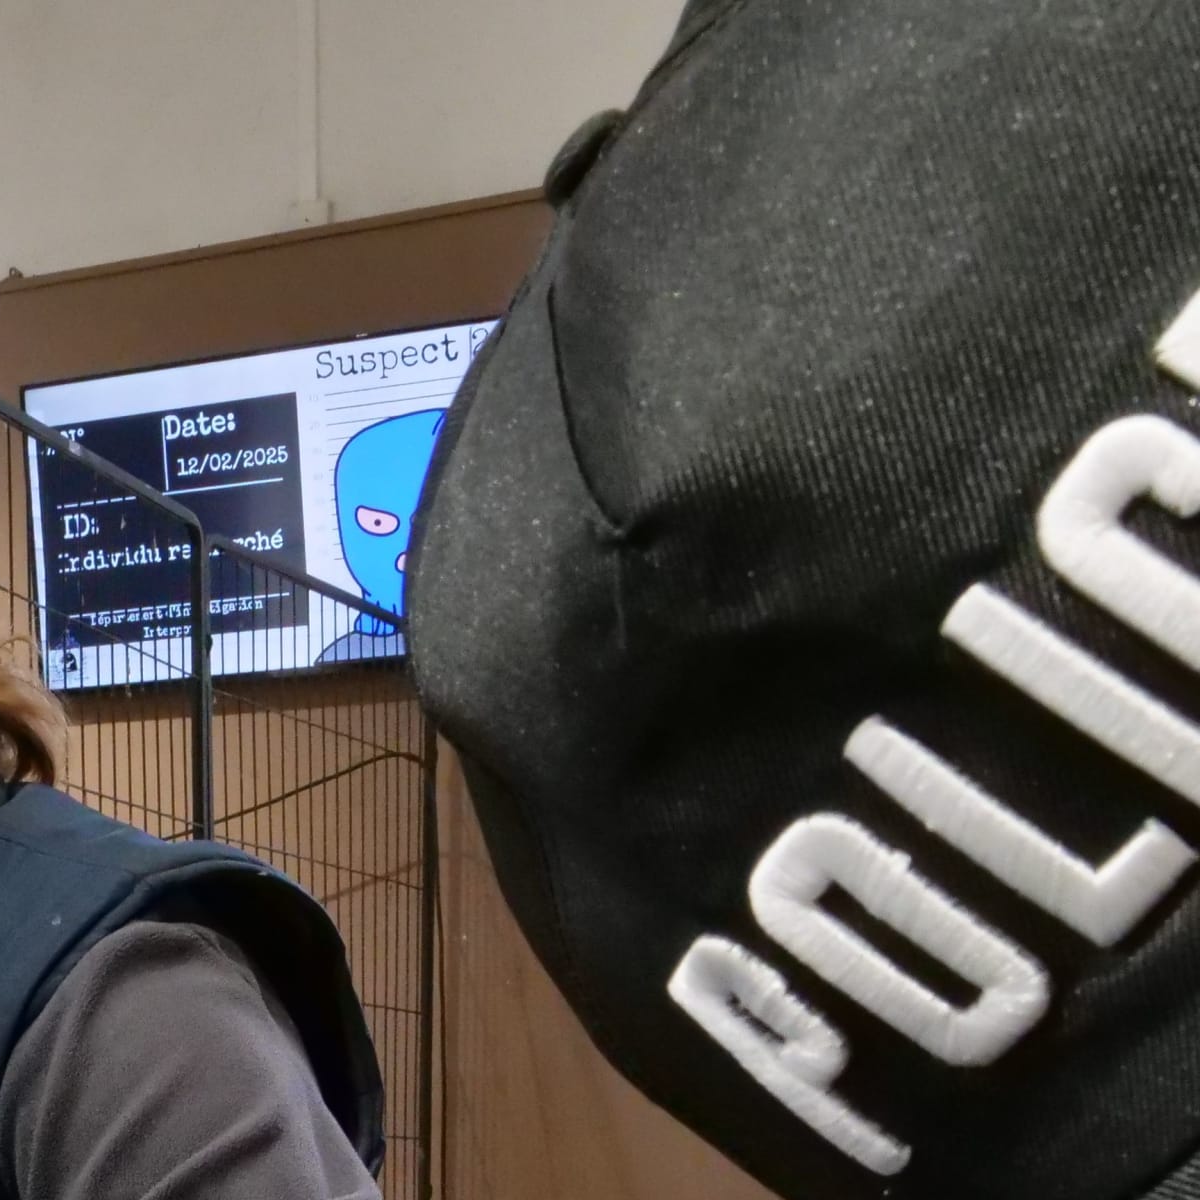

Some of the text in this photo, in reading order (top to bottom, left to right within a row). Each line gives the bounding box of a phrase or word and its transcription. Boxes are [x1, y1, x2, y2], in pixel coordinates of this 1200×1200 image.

[315, 332, 459, 380] Suspect
[164, 411, 236, 440] Date:
[177, 445, 289, 476] 12/02/2025
[63, 511, 100, 540] ID:
[667, 290, 1200, 1177] POLIC
